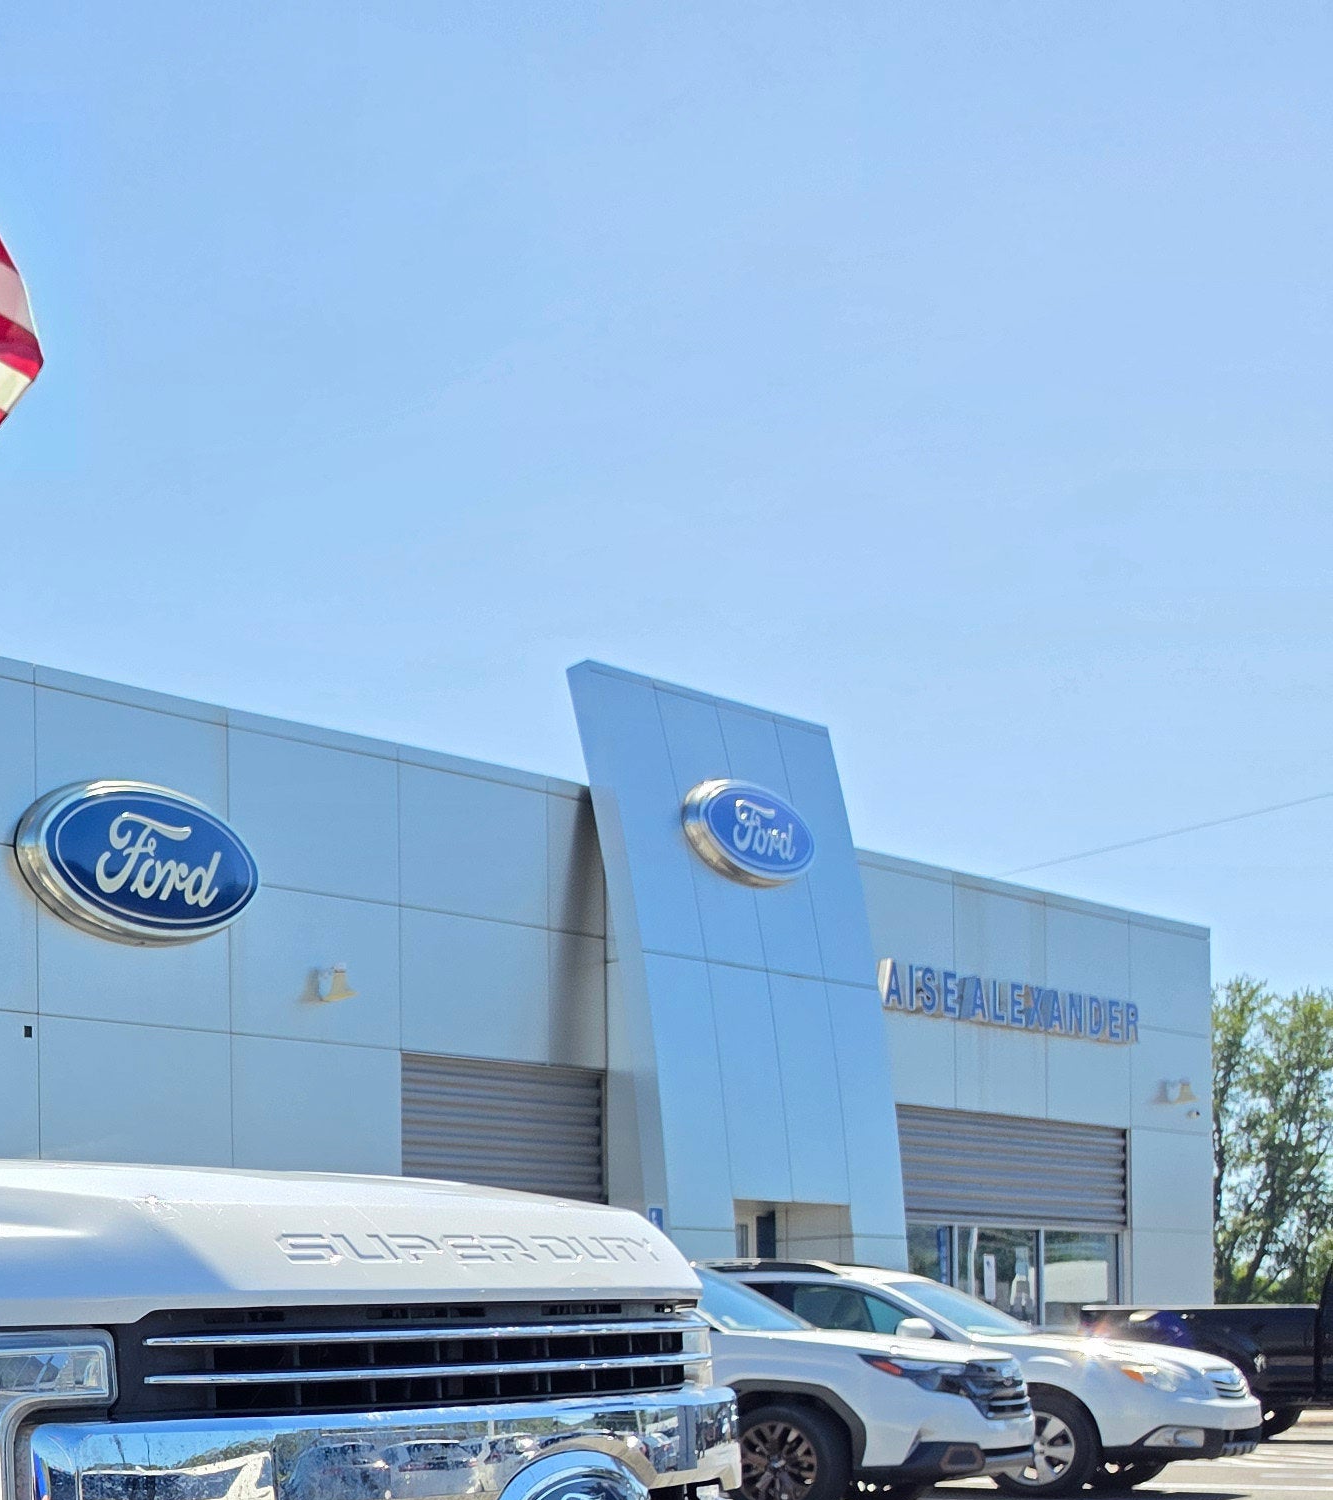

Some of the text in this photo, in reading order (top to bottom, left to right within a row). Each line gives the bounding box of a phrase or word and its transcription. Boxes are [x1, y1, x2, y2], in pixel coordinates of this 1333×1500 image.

[95, 811, 222, 908] Ford
[733, 799, 796, 862] Ford
[969, 975, 1139, 1042] ALEXANDER
